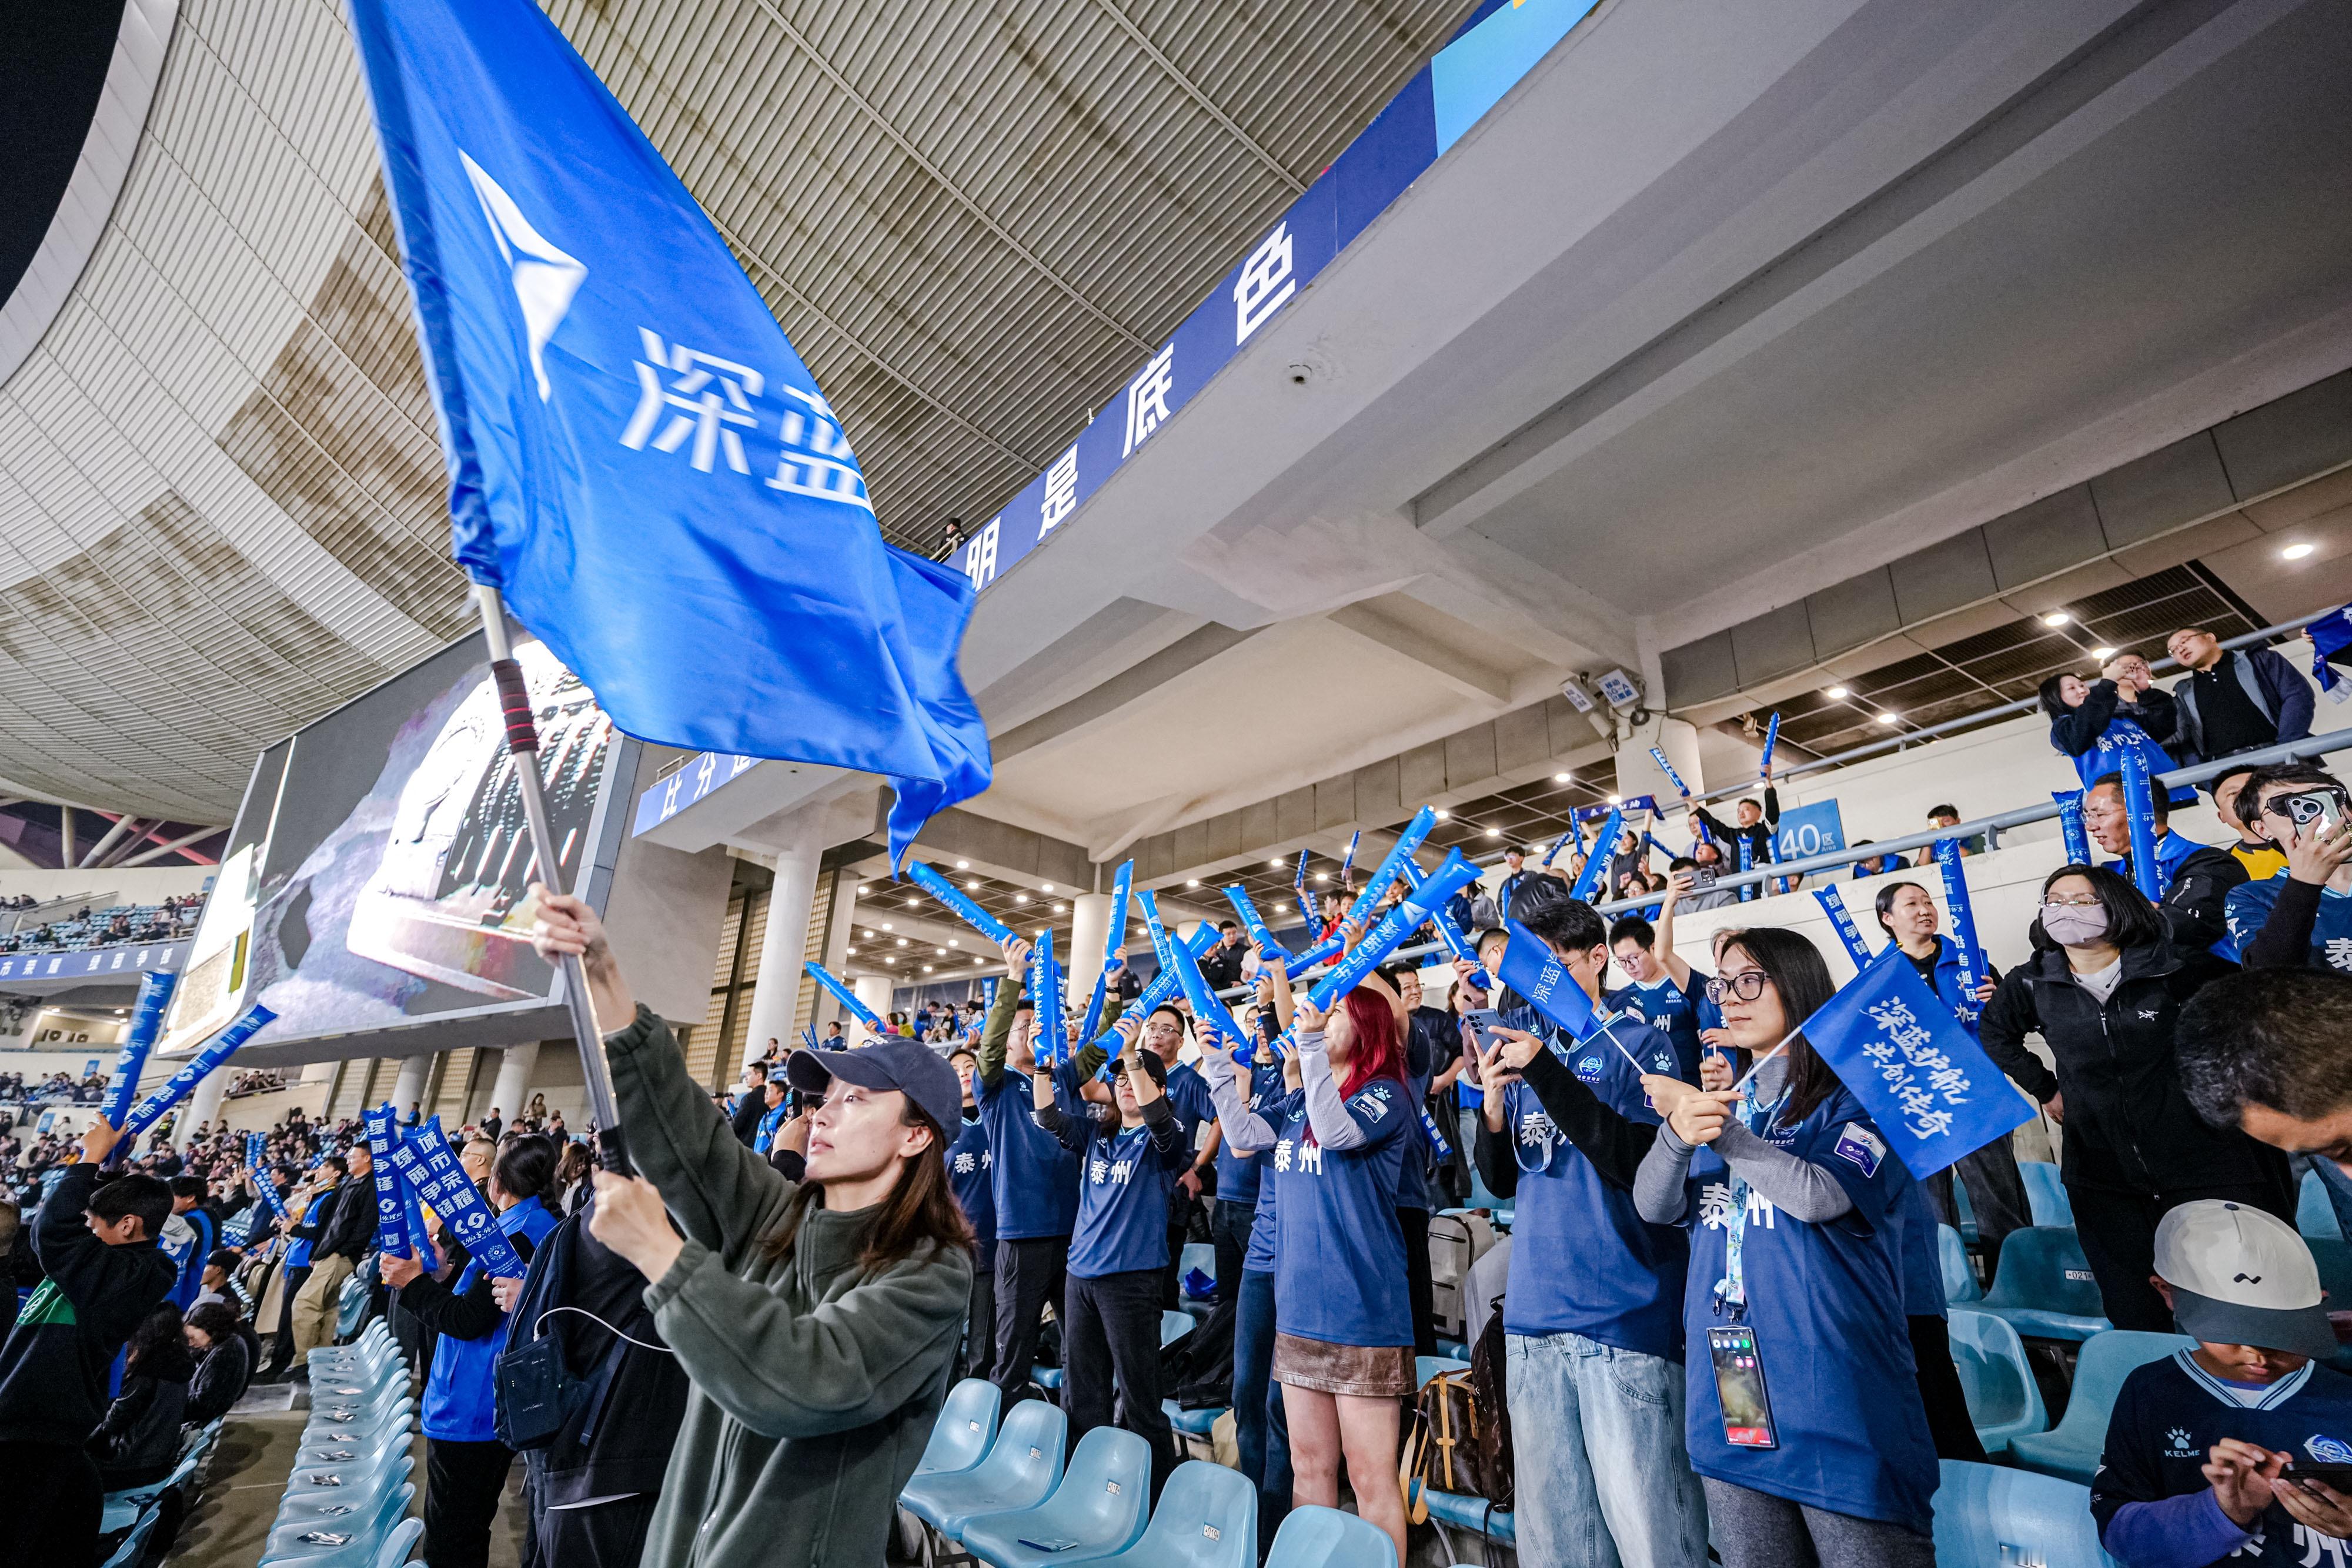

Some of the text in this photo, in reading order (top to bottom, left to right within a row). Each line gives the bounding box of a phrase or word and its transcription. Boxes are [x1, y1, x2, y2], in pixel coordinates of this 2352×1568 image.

[618, 325, 876, 519] 深蓝
[1780, 824, 1835, 860] 40 区
[1859, 995, 1972, 1105] 深蓝护航
[417, 1131, 475, 1210] 城市荣耀
[1091, 1159, 1132, 1185] 泰州
[1274, 1138, 1322, 1176] 泰州
[1699, 1182, 1775, 1230] 泰州
[2072, 1271, 2087, 1279] 021
[2165, 1449, 2200, 1457] KELME
[1207, 1527, 1217, 1540] 019
